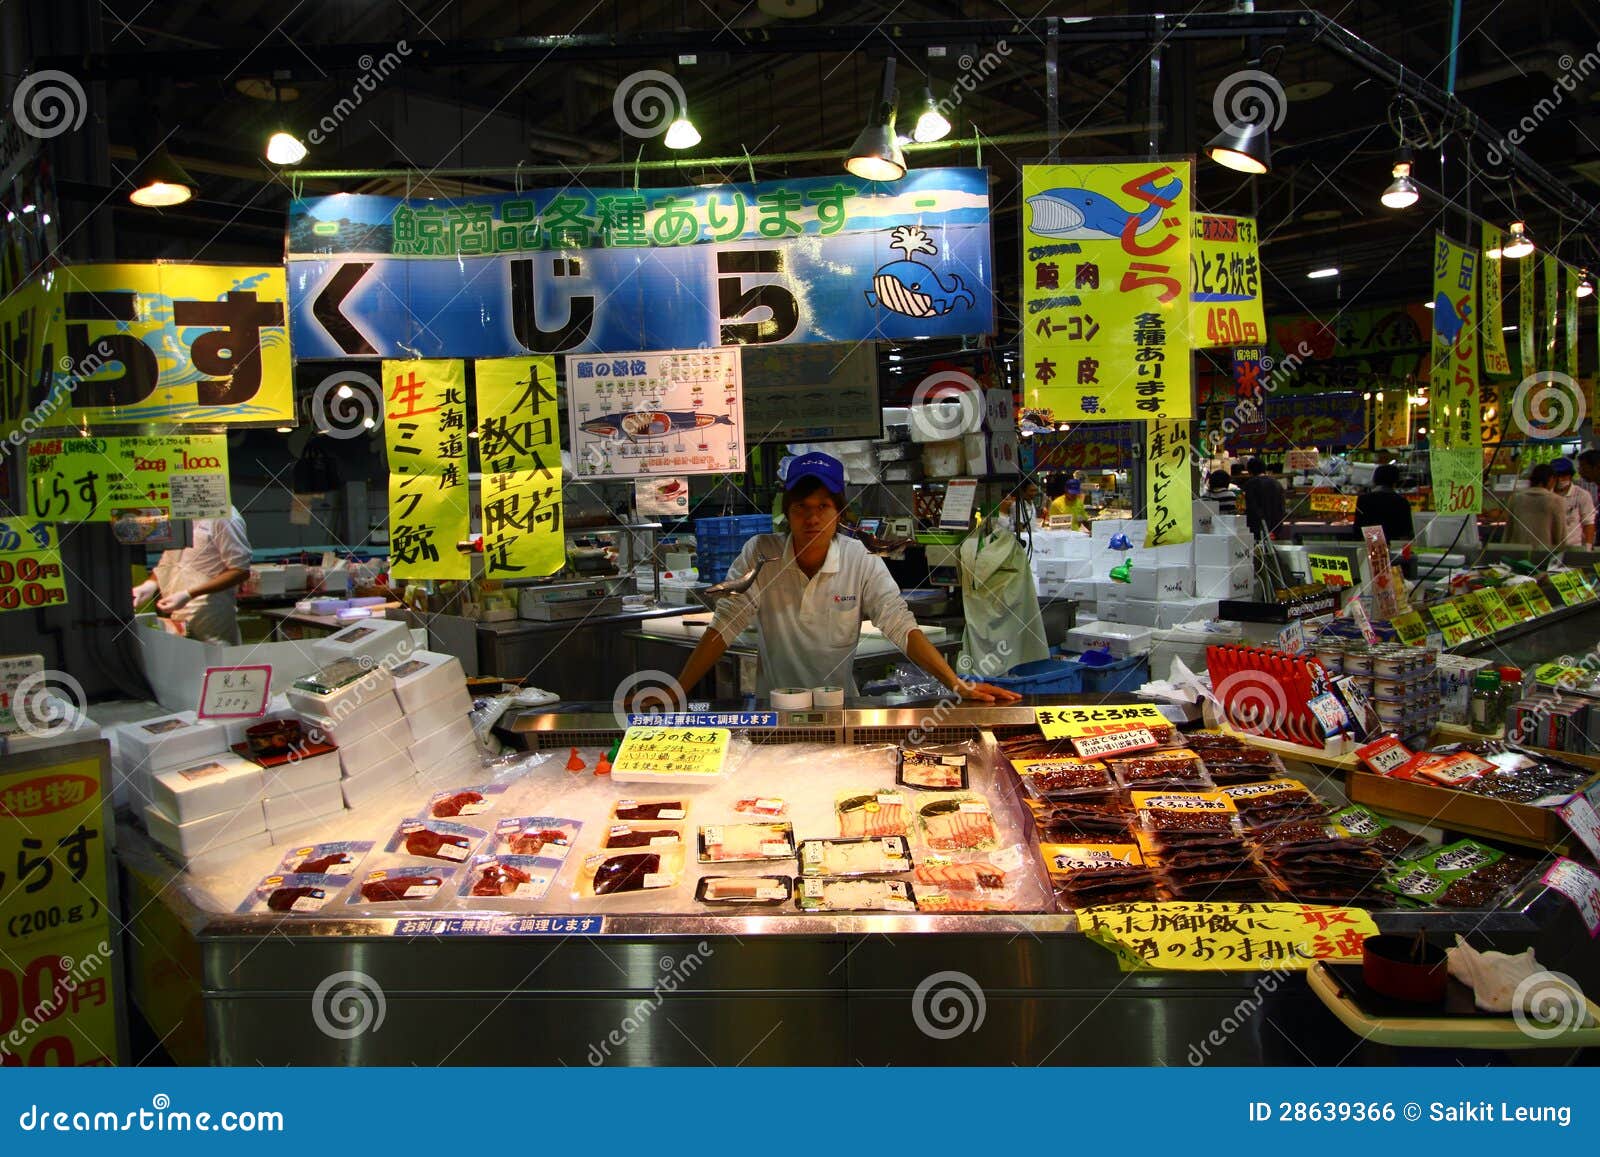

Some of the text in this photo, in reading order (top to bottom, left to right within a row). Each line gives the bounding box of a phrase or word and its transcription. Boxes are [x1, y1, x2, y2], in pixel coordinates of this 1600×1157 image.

[391, 184, 858, 256] 鯨商品各種あります
[1119, 166, 1182, 305] くじら
[1190, 217, 1257, 244] にオススメです。
[312, 250, 800, 356] くじら
[1036, 314, 1100, 342] ベーコン
[1206, 308, 1259, 346] 450円
[1035, 357, 1100, 385] 本皮
[1133, 312, 1167, 419] 各種あります。
[387, 371, 441, 567] 生ミンク鯨
[436, 388, 466, 490] 北海道産
[510, 365, 561, 534] 本日入荷
[32, 470, 99, 520] しらす
[480, 415, 529, 574] 数量限定
[632, 714, 772, 726] お刺身に無料にて調理します
[1039, 708, 1158, 725] まぐろとろ炊き
[0, 825, 98, 893] らす
